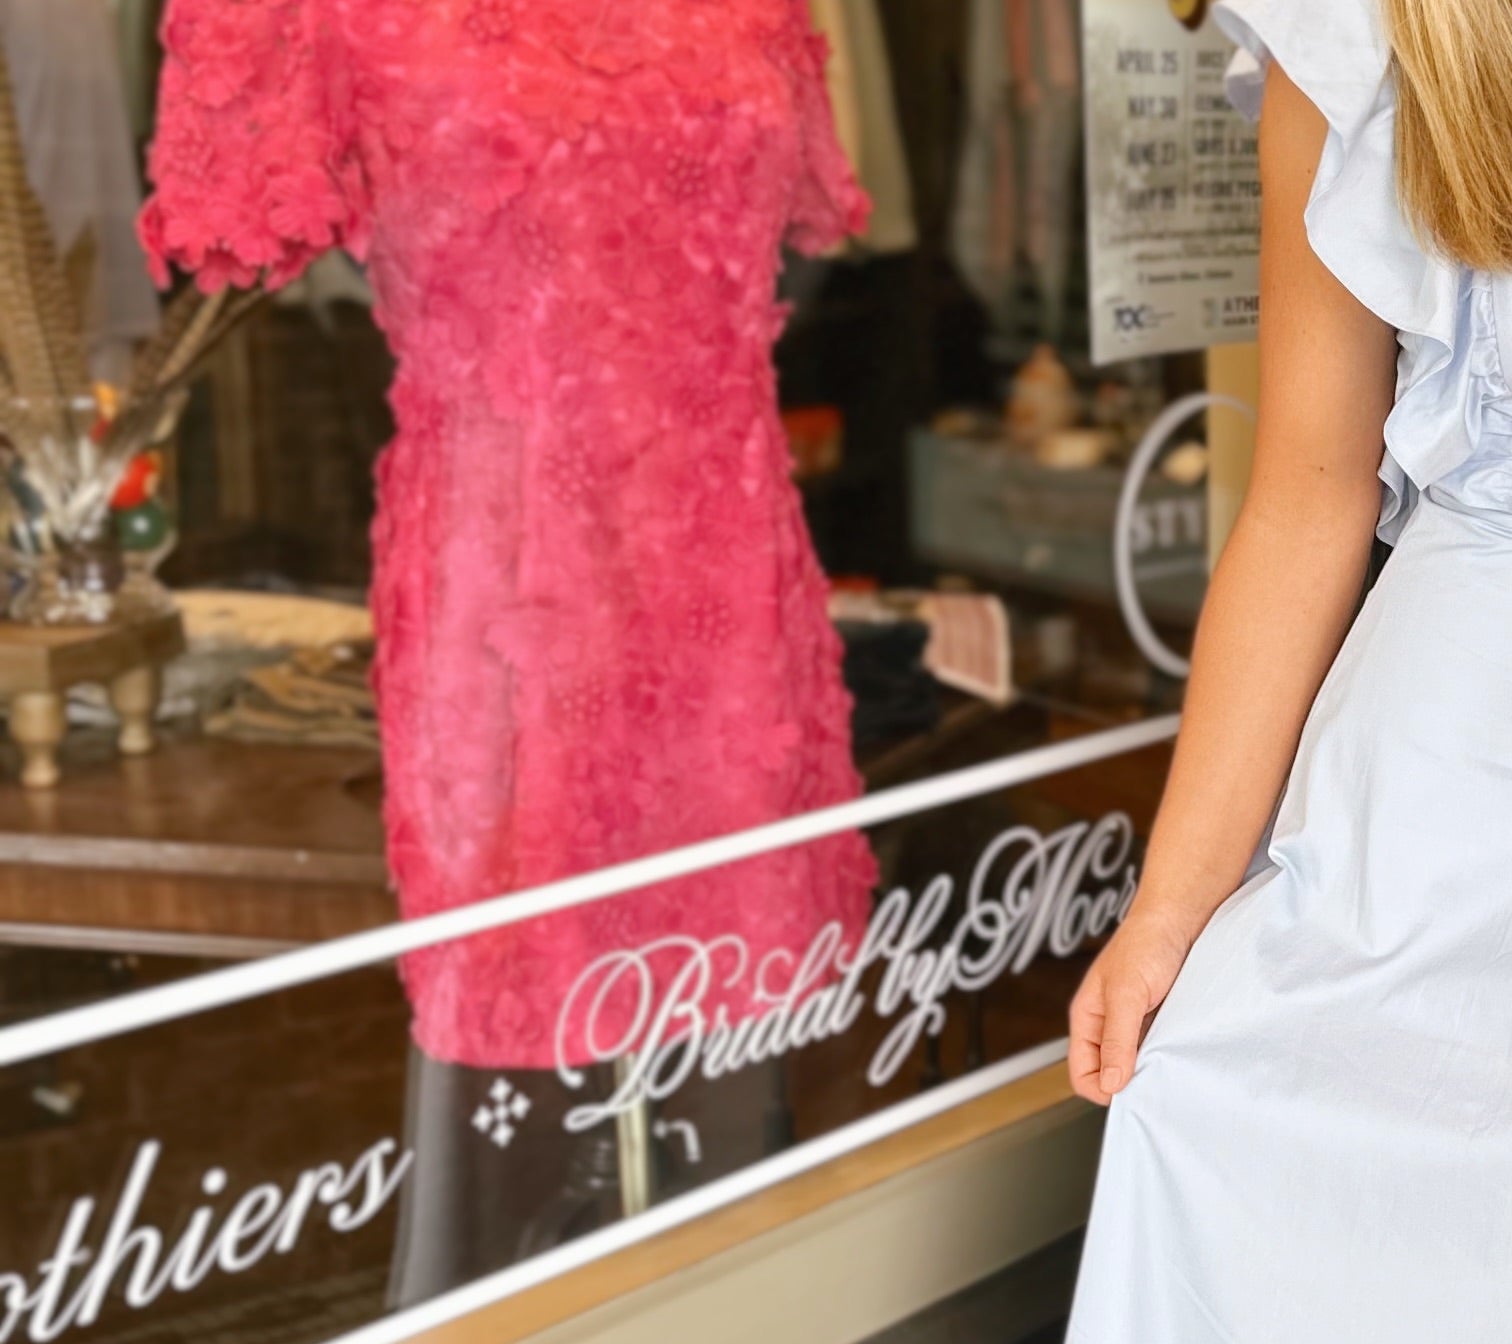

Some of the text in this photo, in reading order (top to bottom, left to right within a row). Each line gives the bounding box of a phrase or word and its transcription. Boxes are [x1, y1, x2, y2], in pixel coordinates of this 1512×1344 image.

[554, 886, 908, 1132] Bridal
[867, 873, 955, 1087] by
[950, 810, 1138, 992] Mor
